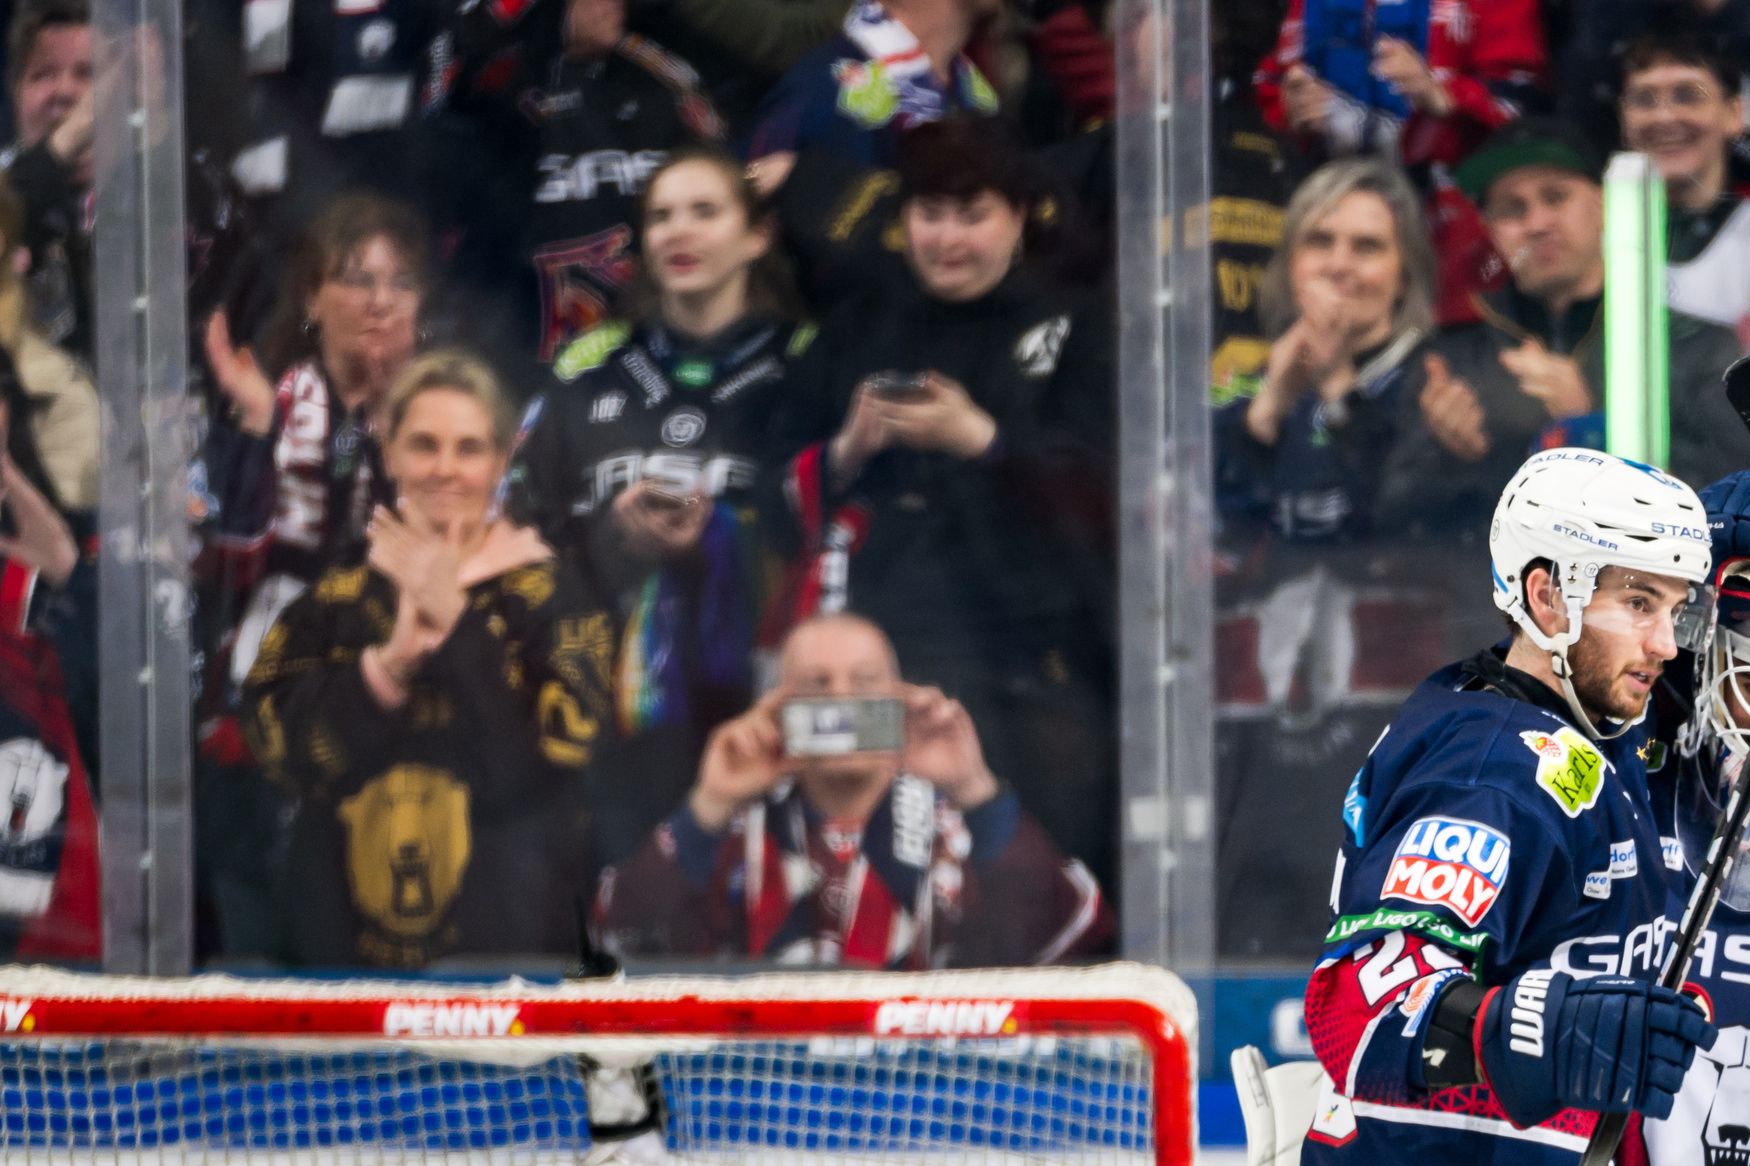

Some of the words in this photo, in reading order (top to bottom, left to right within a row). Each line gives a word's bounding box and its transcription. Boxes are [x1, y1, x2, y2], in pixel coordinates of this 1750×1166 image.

[1515, 452, 1604, 468] ADLER
[1553, 523, 1618, 551] STADLER
[1552, 742, 1599, 805] Karls
[1403, 821, 1510, 883] LIQUI
[1385, 864, 1496, 919] MOLY
[1372, 908, 1415, 927] LIGO
[384, 1004, 525, 1039] PENNY.
[873, 1001, 1018, 1036] PENNY.
